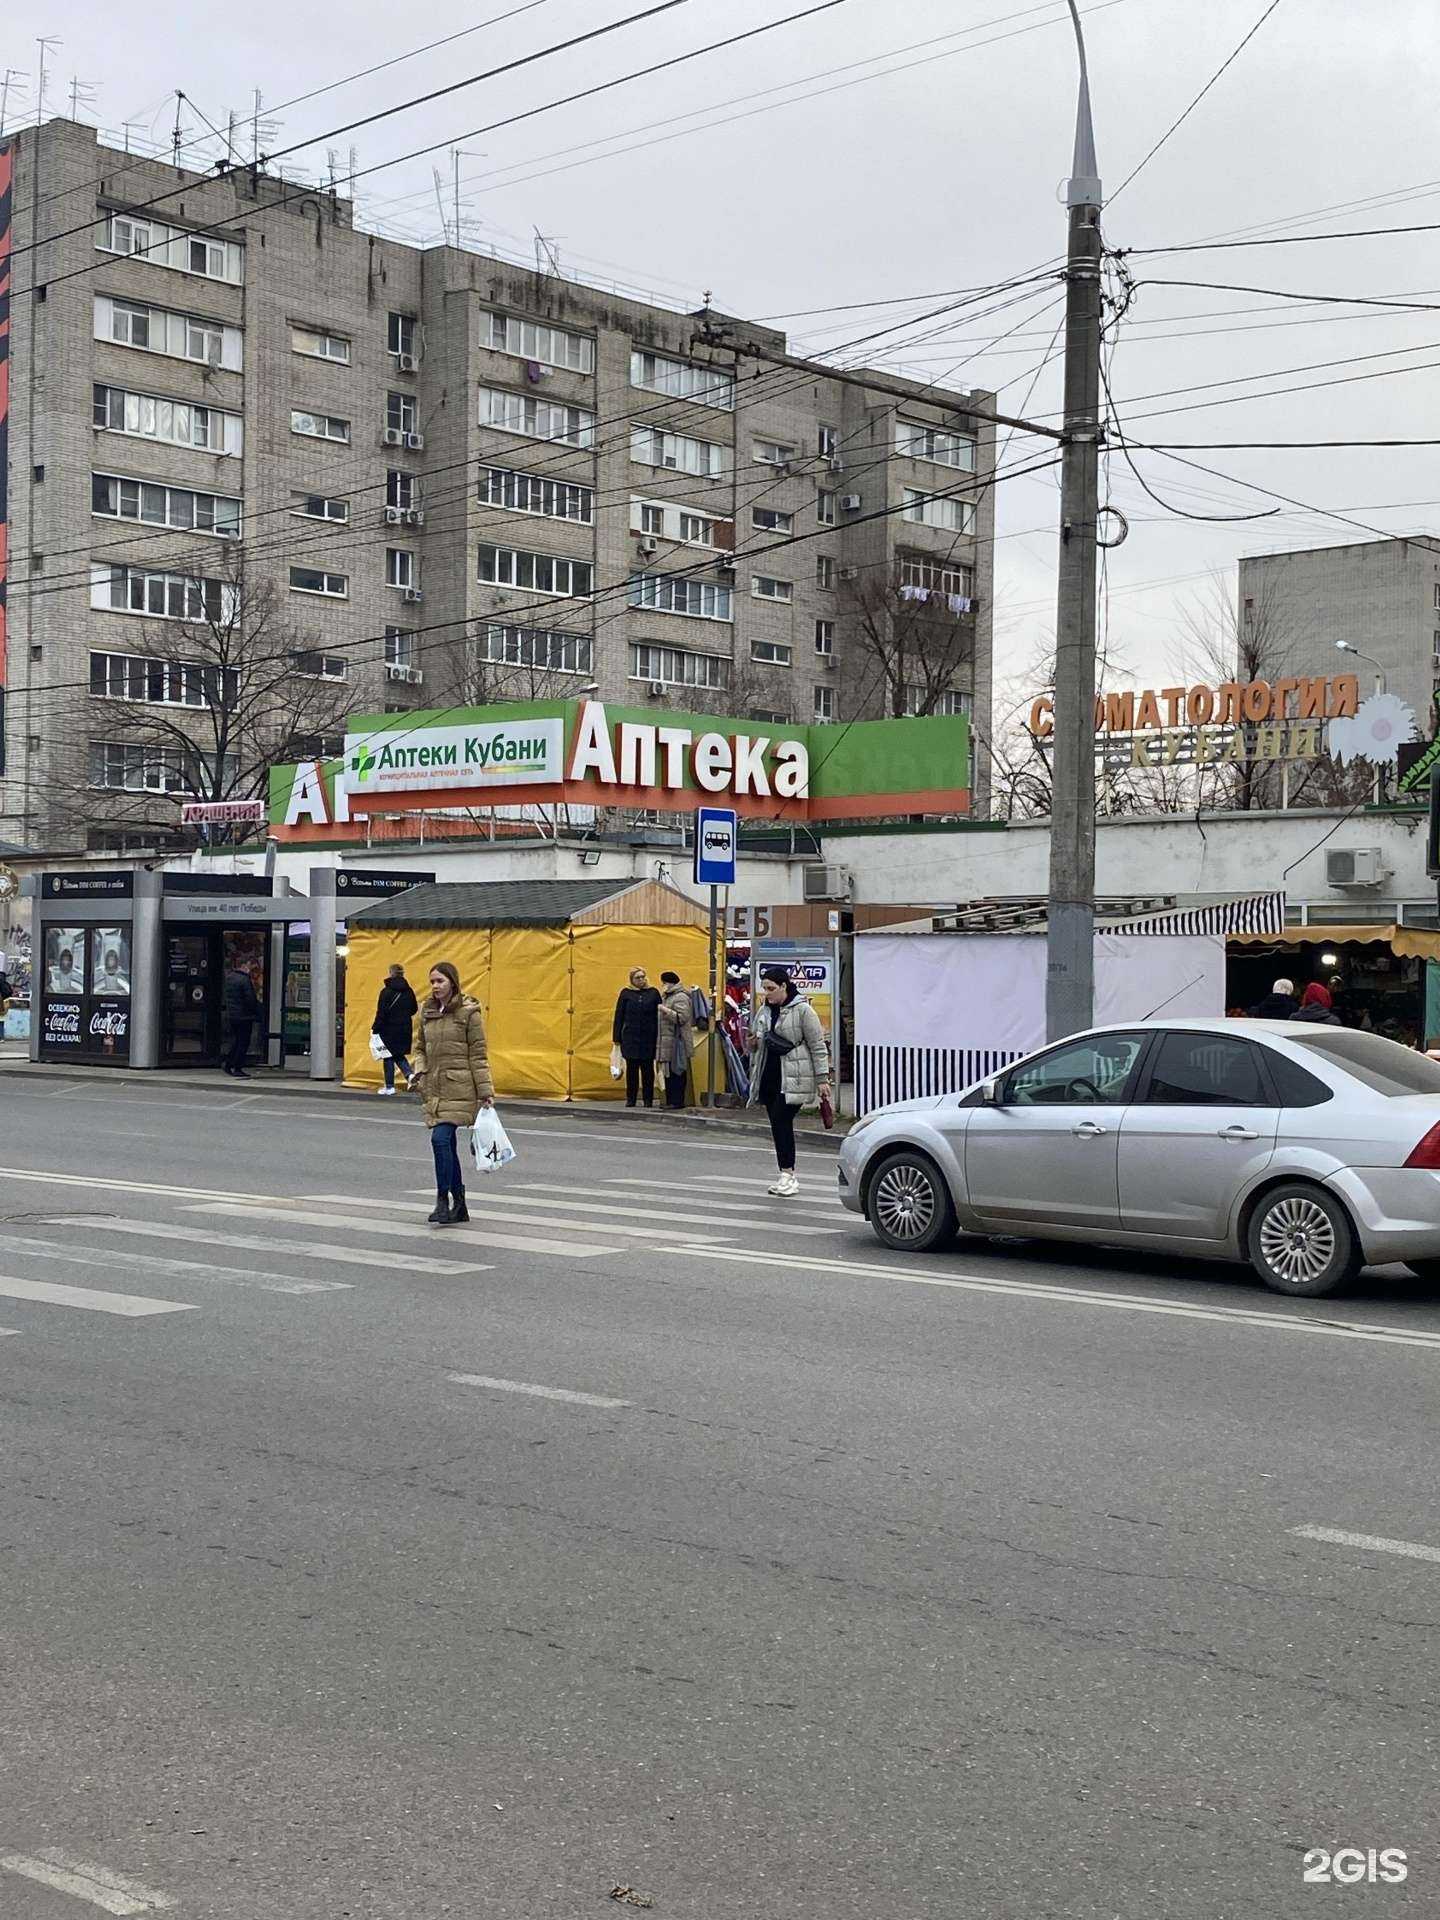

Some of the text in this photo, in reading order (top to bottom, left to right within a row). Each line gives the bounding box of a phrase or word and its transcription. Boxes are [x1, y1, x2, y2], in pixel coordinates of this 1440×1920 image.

[1030, 674, 1358, 736] СМАТОЛОГИЯ
[377, 734, 547, 769] Аптеки Кубани
[567, 701, 810, 799] Аптека
[1131, 726, 1320, 767] КУБАНИ
[717, 907, 769, 938] ЕБ
